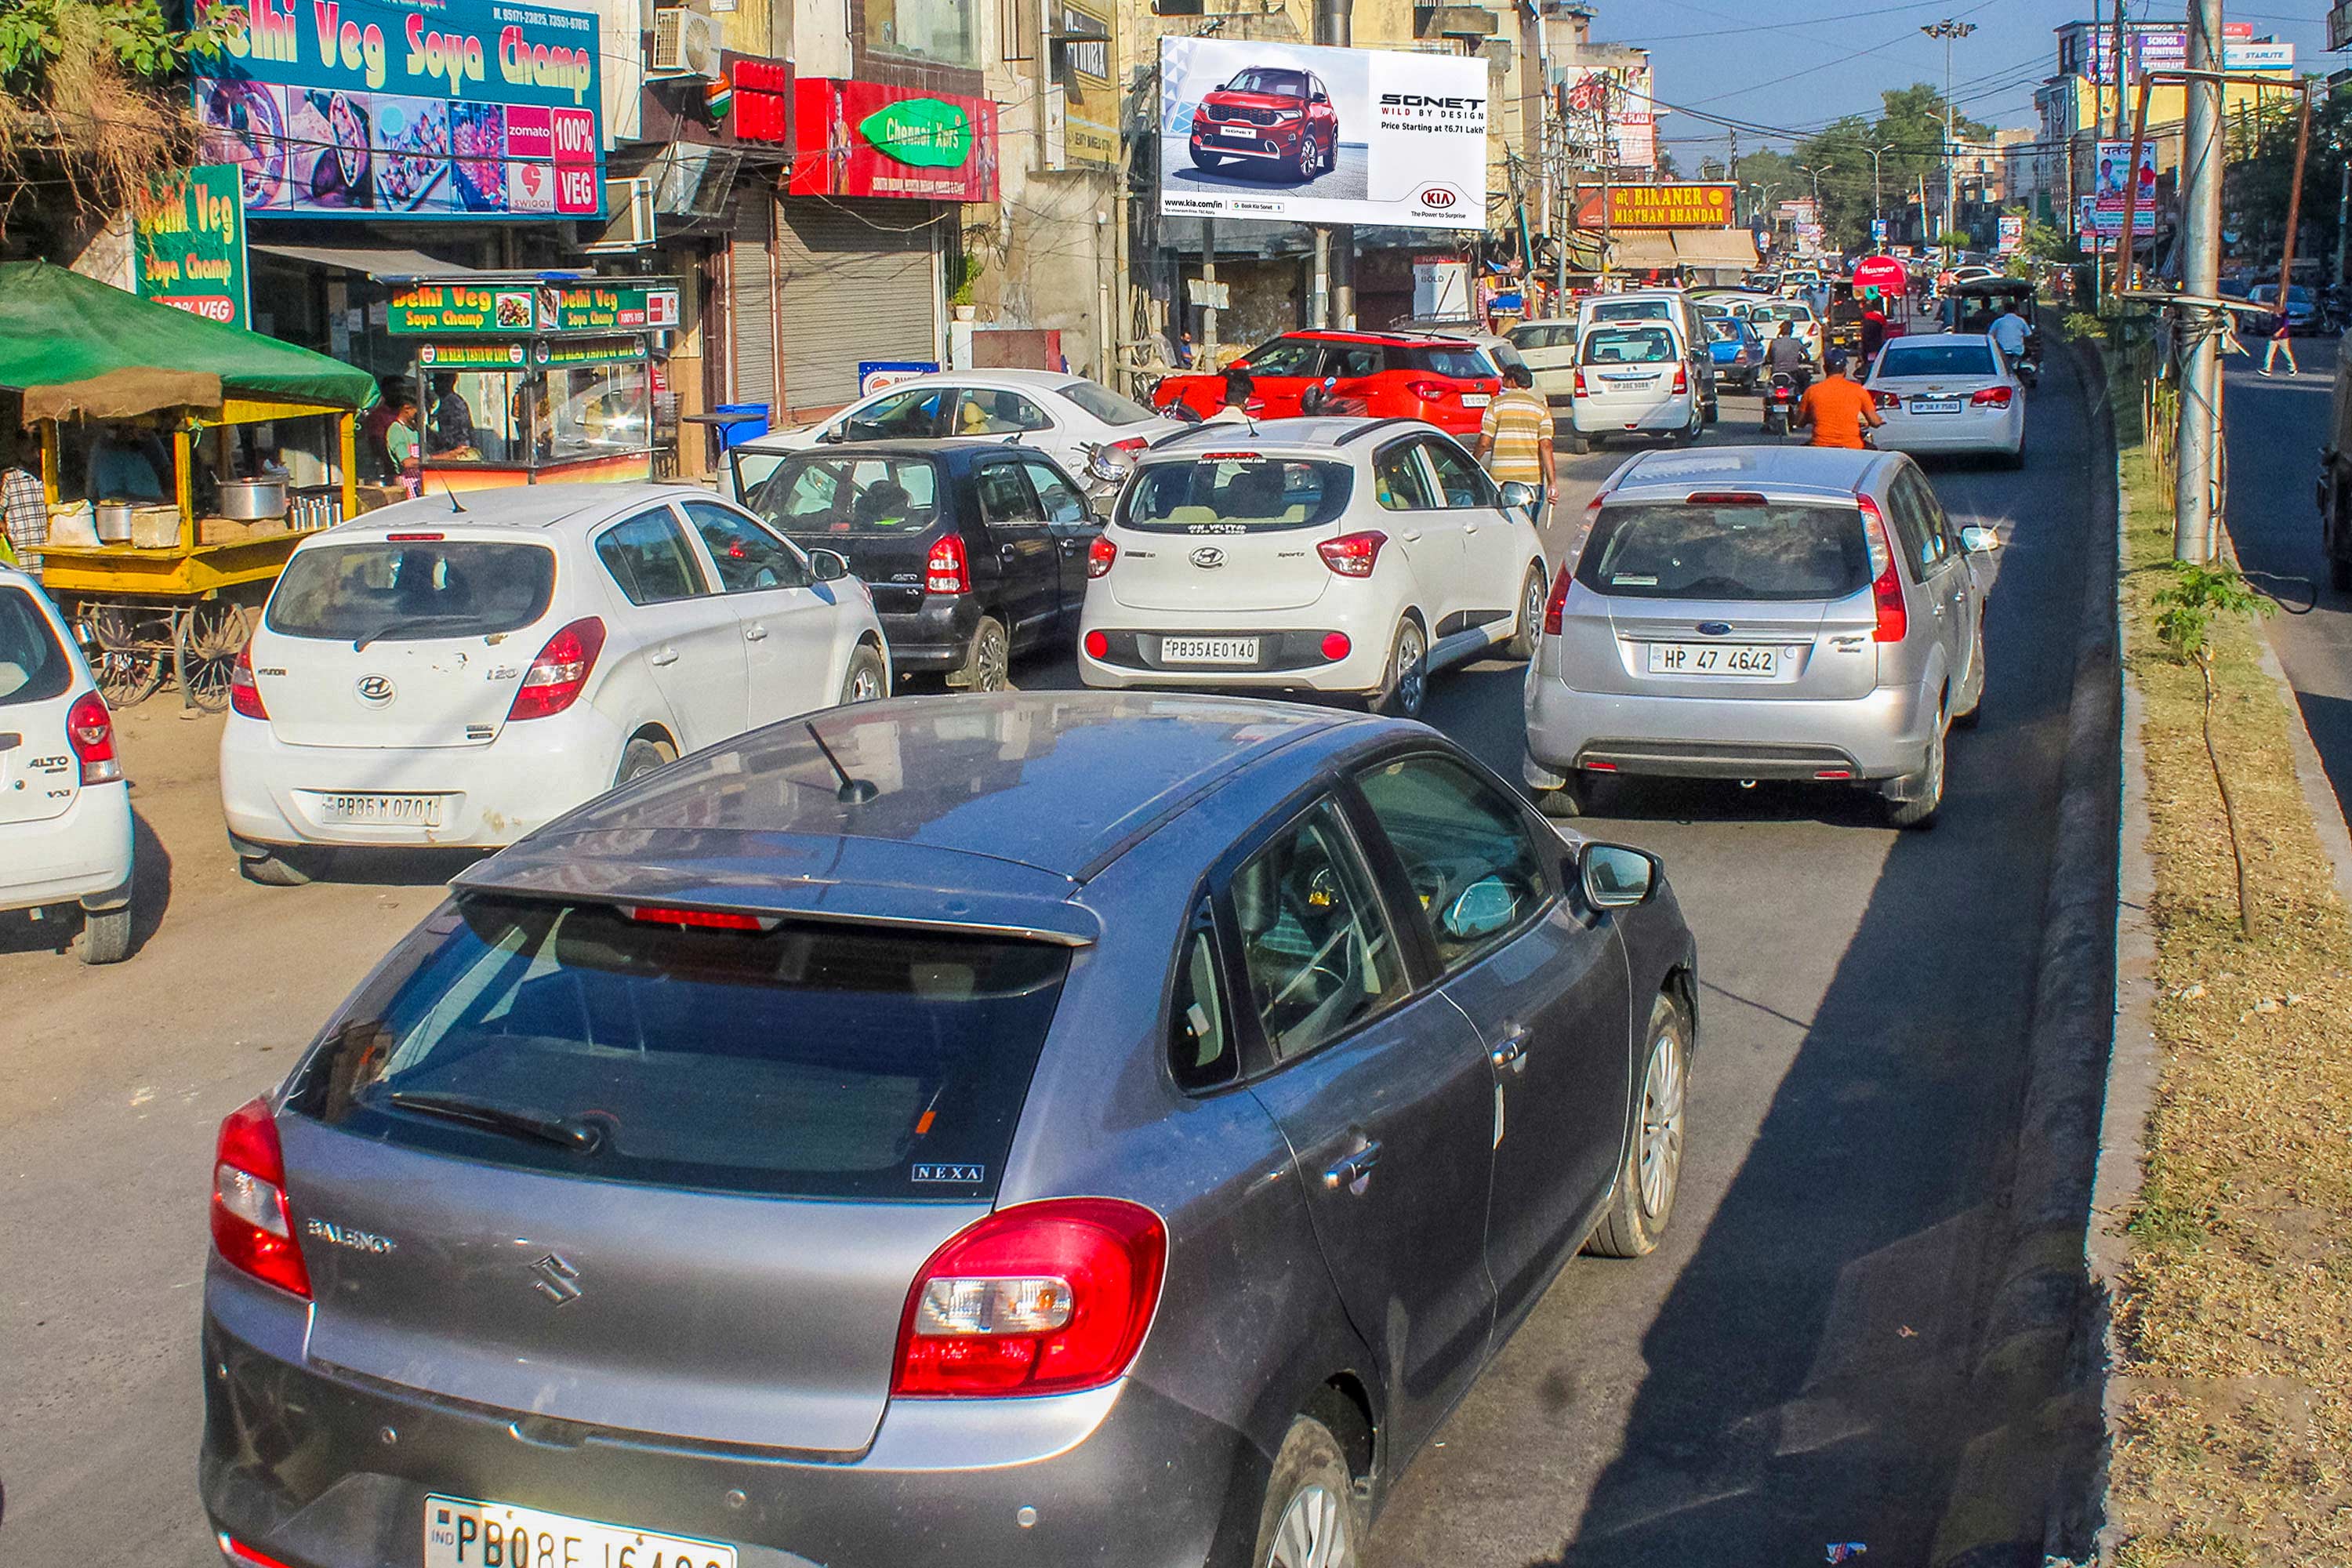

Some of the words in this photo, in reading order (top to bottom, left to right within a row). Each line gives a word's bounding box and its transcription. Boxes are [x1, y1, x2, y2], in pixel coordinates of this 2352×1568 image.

[2147, 36, 2178, 45] SCHOOL
[314, 1, 386, 89] Veg
[405, 13, 485, 96] Soya
[499, 25, 591, 105] Champ
[2141, 47, 2184, 56] FURNITURE
[1379, 94, 1486, 111] SONET
[1381, 107, 1410, 116] WILD
[1441, 111, 1484, 120] DESIGN
[1628, 114, 1649, 124] PLAZA
[509, 126, 550, 137] zomato
[556, 117, 593, 153] 100%
[1381, 122, 1399, 130] Price
[1402, 122, 1432, 133] Starting
[561, 171, 593, 205] VEG
[1165, 199, 1222, 209] www.kia.com/in
[1427, 193, 1450, 204] KIA
[194, 183, 234, 245] Veg
[1669, 209, 1724, 223] BHANDAR
[185, 252, 231, 286] Champ
[451, 286, 492, 311] Veg
[561, 289, 591, 308] Delhi
[594, 289, 618, 311] Veg
[198, 300, 230, 320] VEG
[405, 310, 437, 329] Soya
[442, 310, 485, 329] Champ
[568, 312, 587, 328] Soya
[590, 310, 614, 328] Champ
[1172, 642, 1254, 658] PB35AE0140
[1665, 650, 1686, 668] HP
[1697, 652, 1717, 669] 47
[1729, 652, 1772, 670] 4642
[27, 756, 69, 768] ALTO
[338, 797, 375, 816] PB35
[394, 799, 435, 818] 0701
[918, 1167, 978, 1180] NEXA
[431, 1529, 455, 1546] IND
